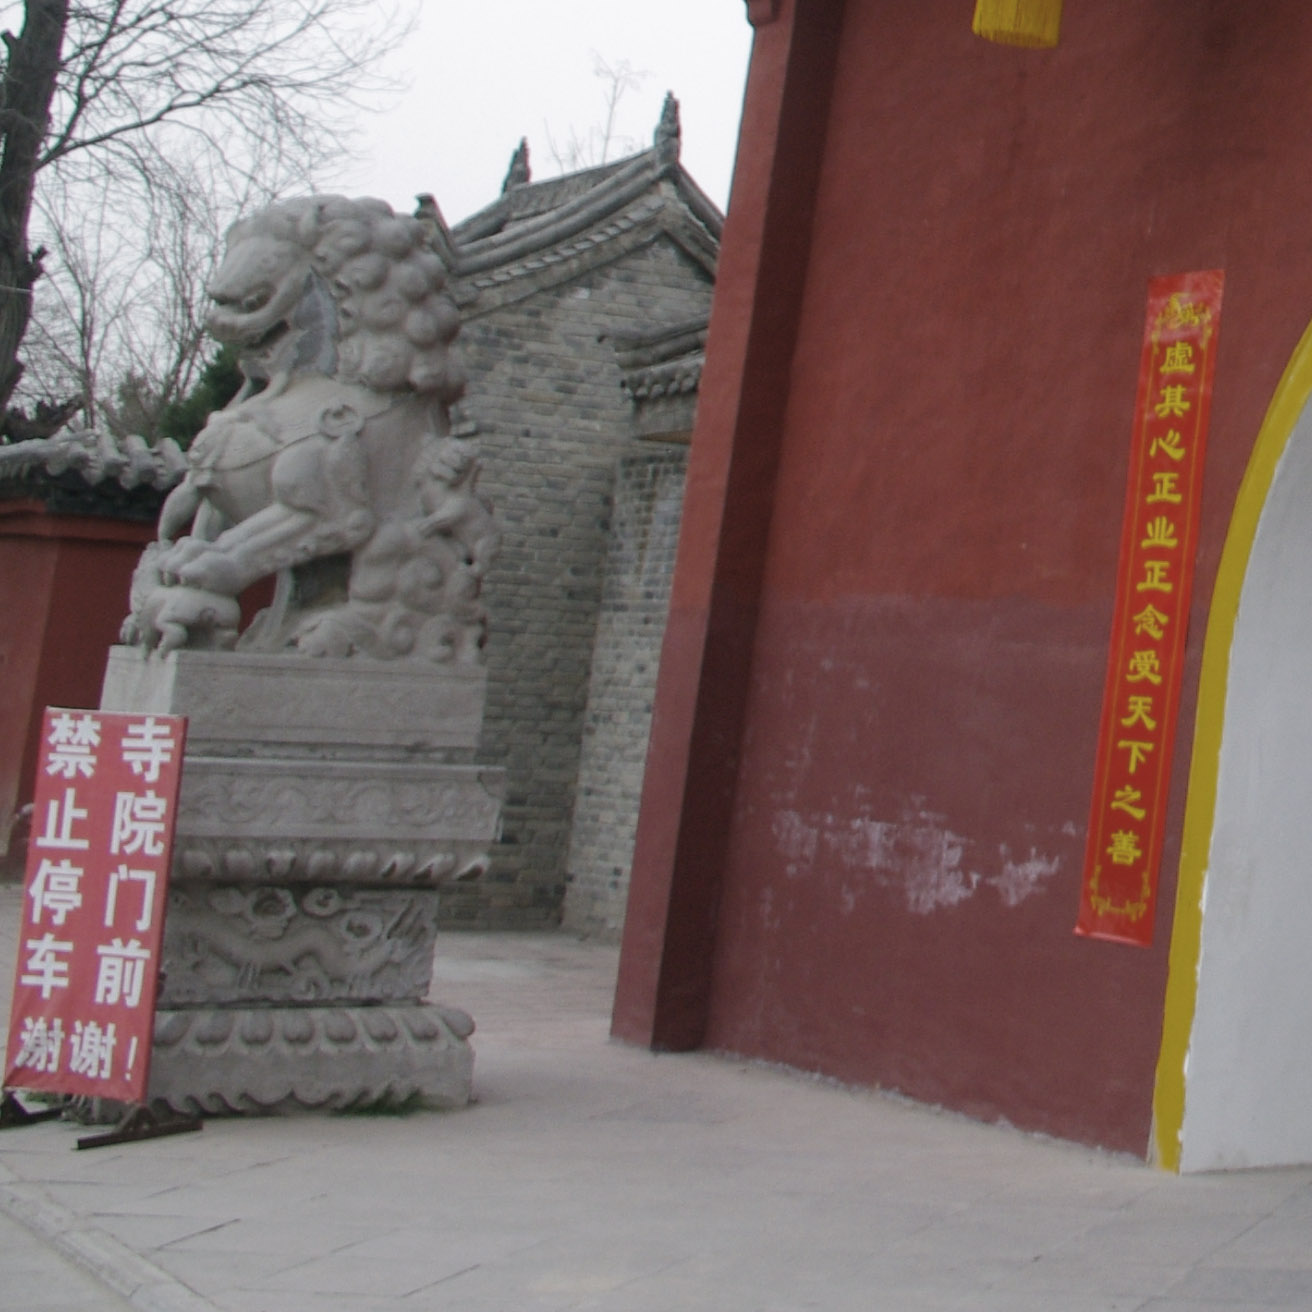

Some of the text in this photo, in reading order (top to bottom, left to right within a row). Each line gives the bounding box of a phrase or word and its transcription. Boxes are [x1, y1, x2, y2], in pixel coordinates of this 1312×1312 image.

[21, 713, 101, 999] 禁止停车
[95, 717, 176, 1009] 寺院门前
